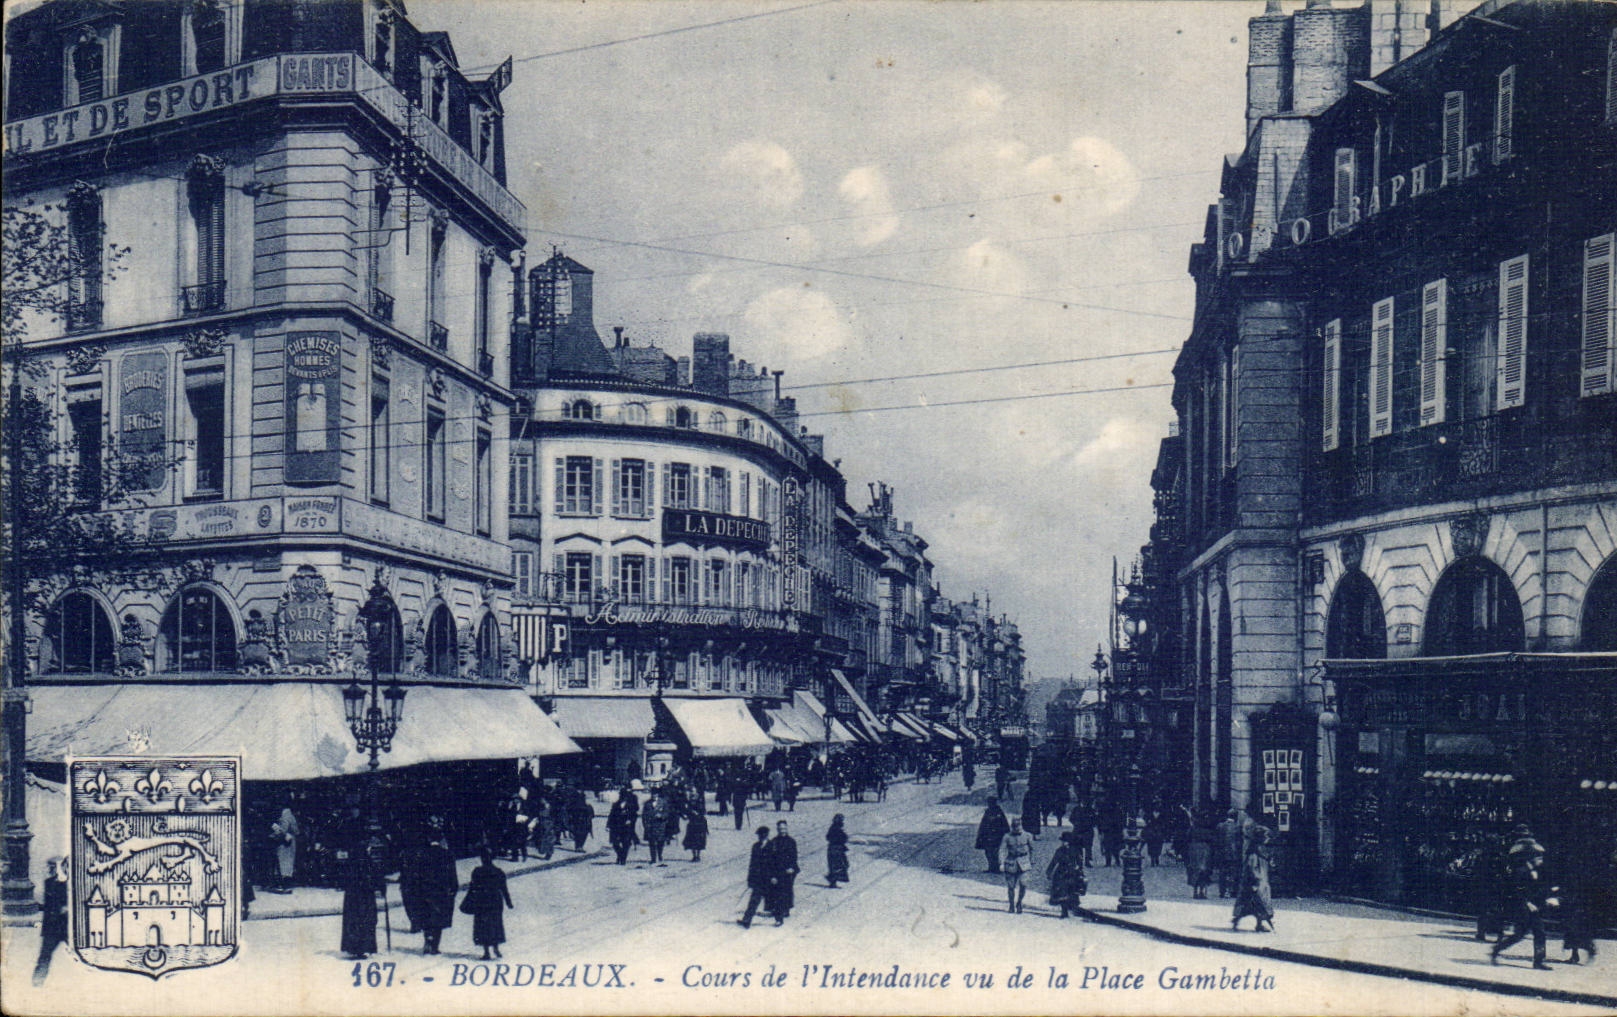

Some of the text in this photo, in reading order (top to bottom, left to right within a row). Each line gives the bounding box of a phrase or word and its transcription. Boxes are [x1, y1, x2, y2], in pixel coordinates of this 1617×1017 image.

[282, 55, 351, 90] GANTS
[42, 111, 80, 148] ET
[89, 99, 130, 136] DE
[143, 66, 255, 123] SPORT
[287, 337, 340, 356] CHEMISES
[294, 355, 331, 366] HOMMES
[784, 483, 796, 506] LA
[295, 516, 328, 529] 1870
[684, 514, 709, 534] LA
[288, 605, 326, 621] PETIT
[288, 628, 327, 642] PARIS
[552, 623, 567, 653] P
